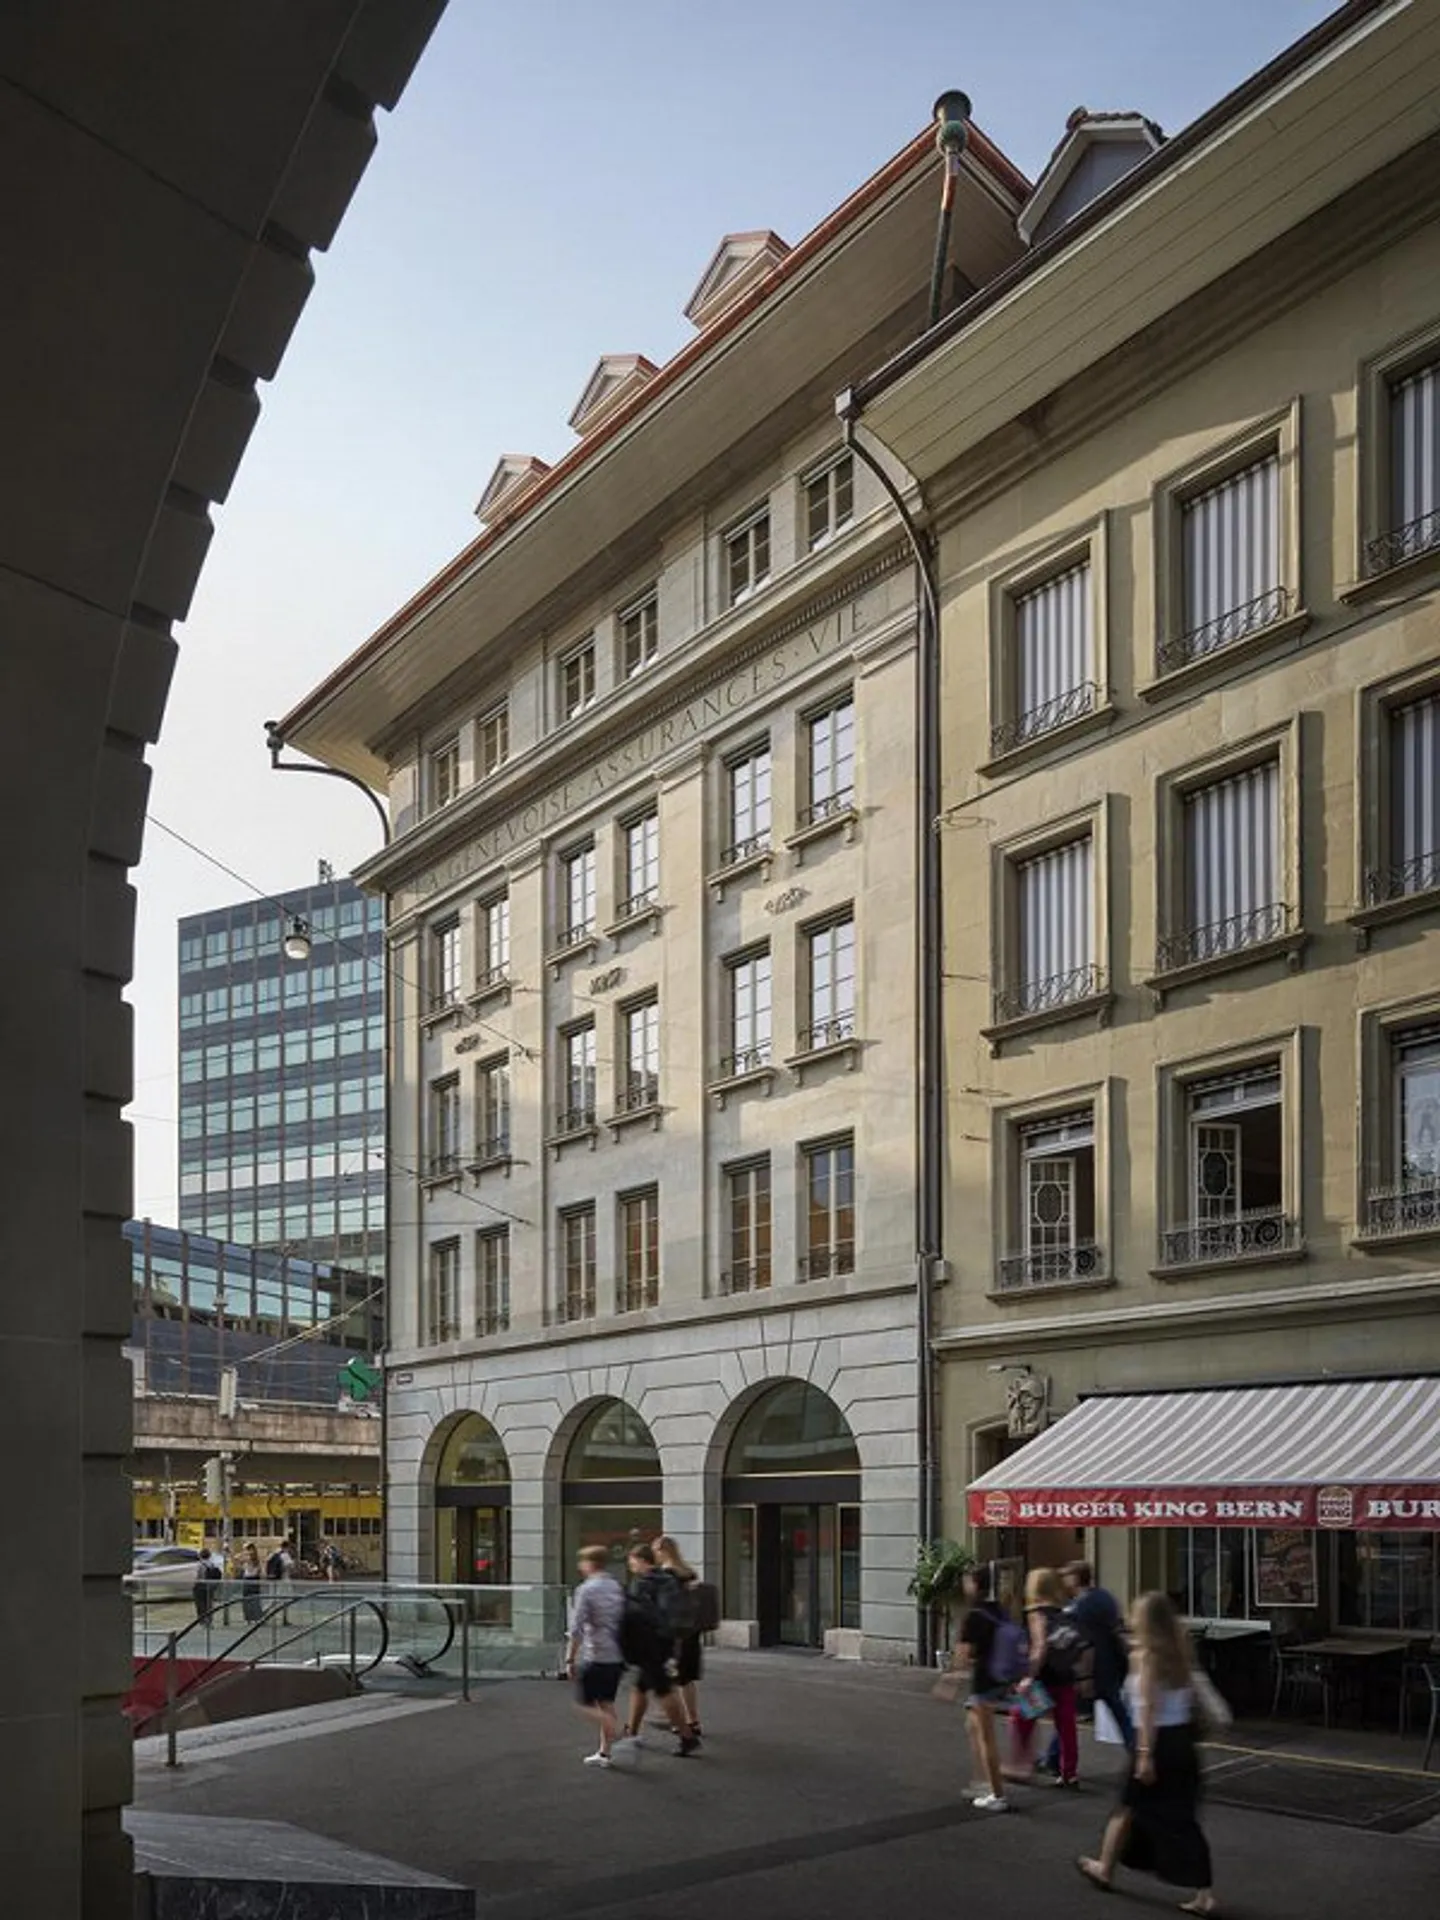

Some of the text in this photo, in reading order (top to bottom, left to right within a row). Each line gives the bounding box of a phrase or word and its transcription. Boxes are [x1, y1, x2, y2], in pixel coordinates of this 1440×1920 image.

[588, 650, 787, 797] ASSURANCES
[806, 602, 863, 654] VIE
[1019, 1502, 1127, 1518] BURGER
[1133, 1501, 1208, 1518] KING
[1215, 1501, 1304, 1518] BERN
